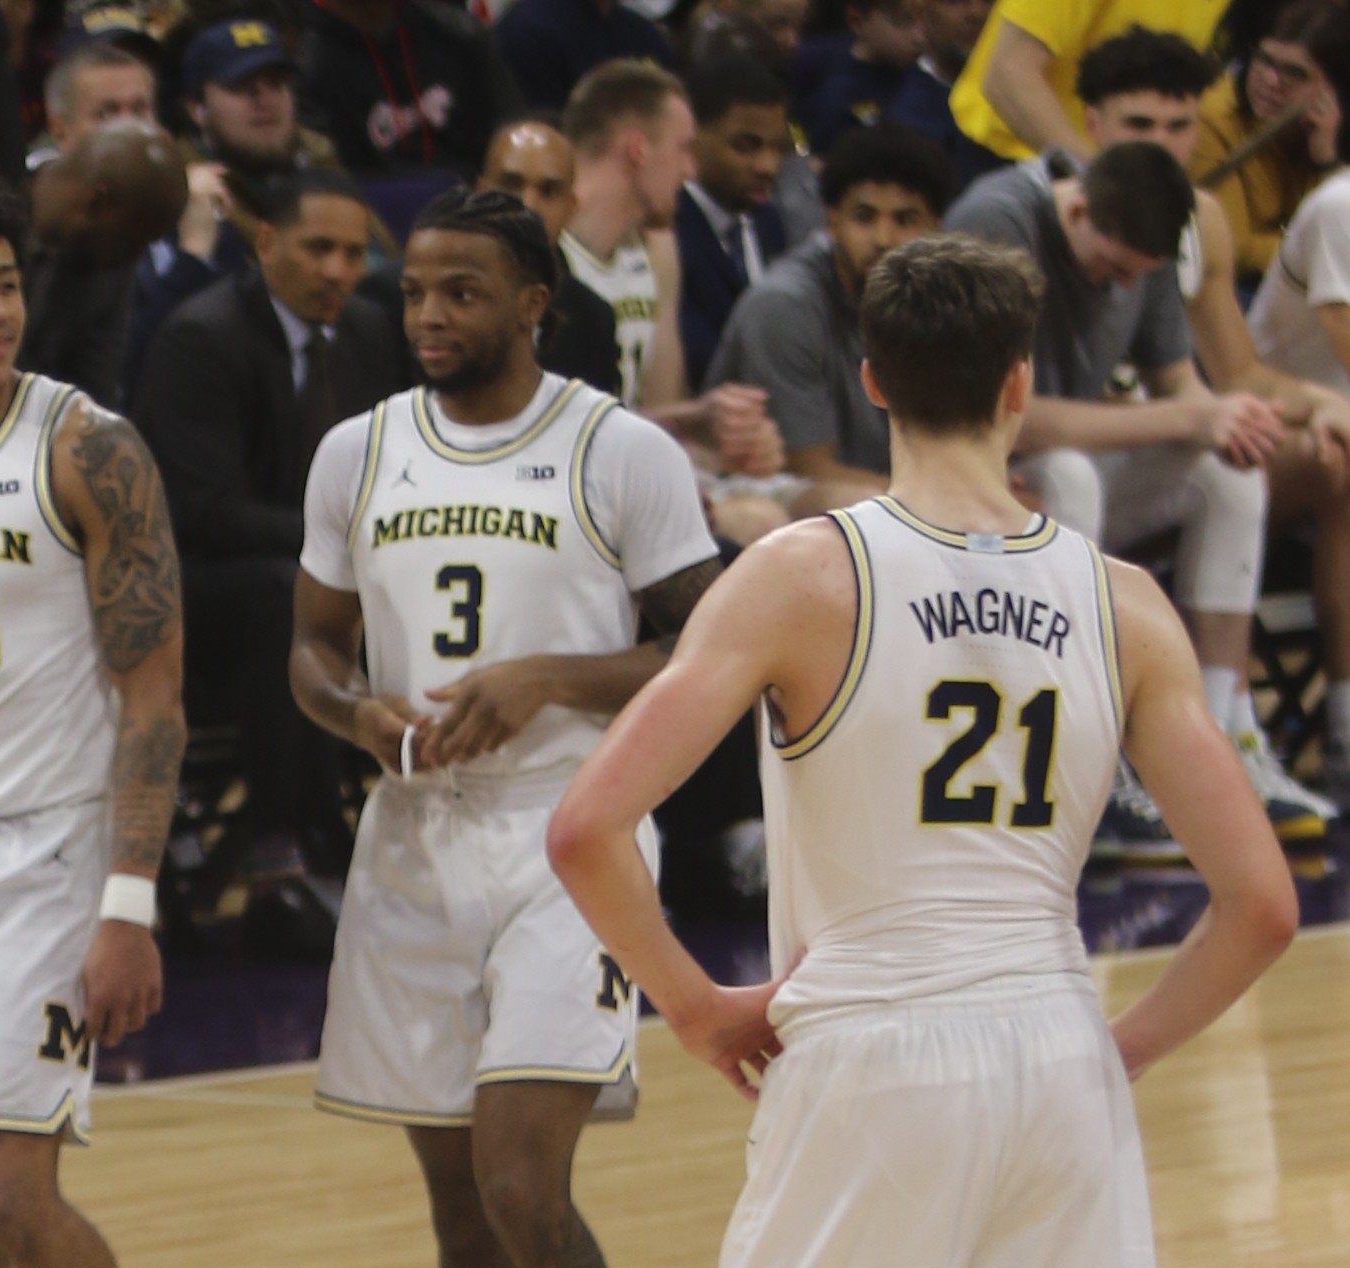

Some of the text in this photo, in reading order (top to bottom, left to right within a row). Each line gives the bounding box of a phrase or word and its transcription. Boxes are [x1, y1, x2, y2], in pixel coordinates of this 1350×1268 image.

[370, 505, 559, 551] MICHIGAN
[433, 561, 484, 659] 3
[909, 588, 1070, 659] WAGNER
[918, 677, 1060, 829] 21
[37, 1000, 90, 1071] M
